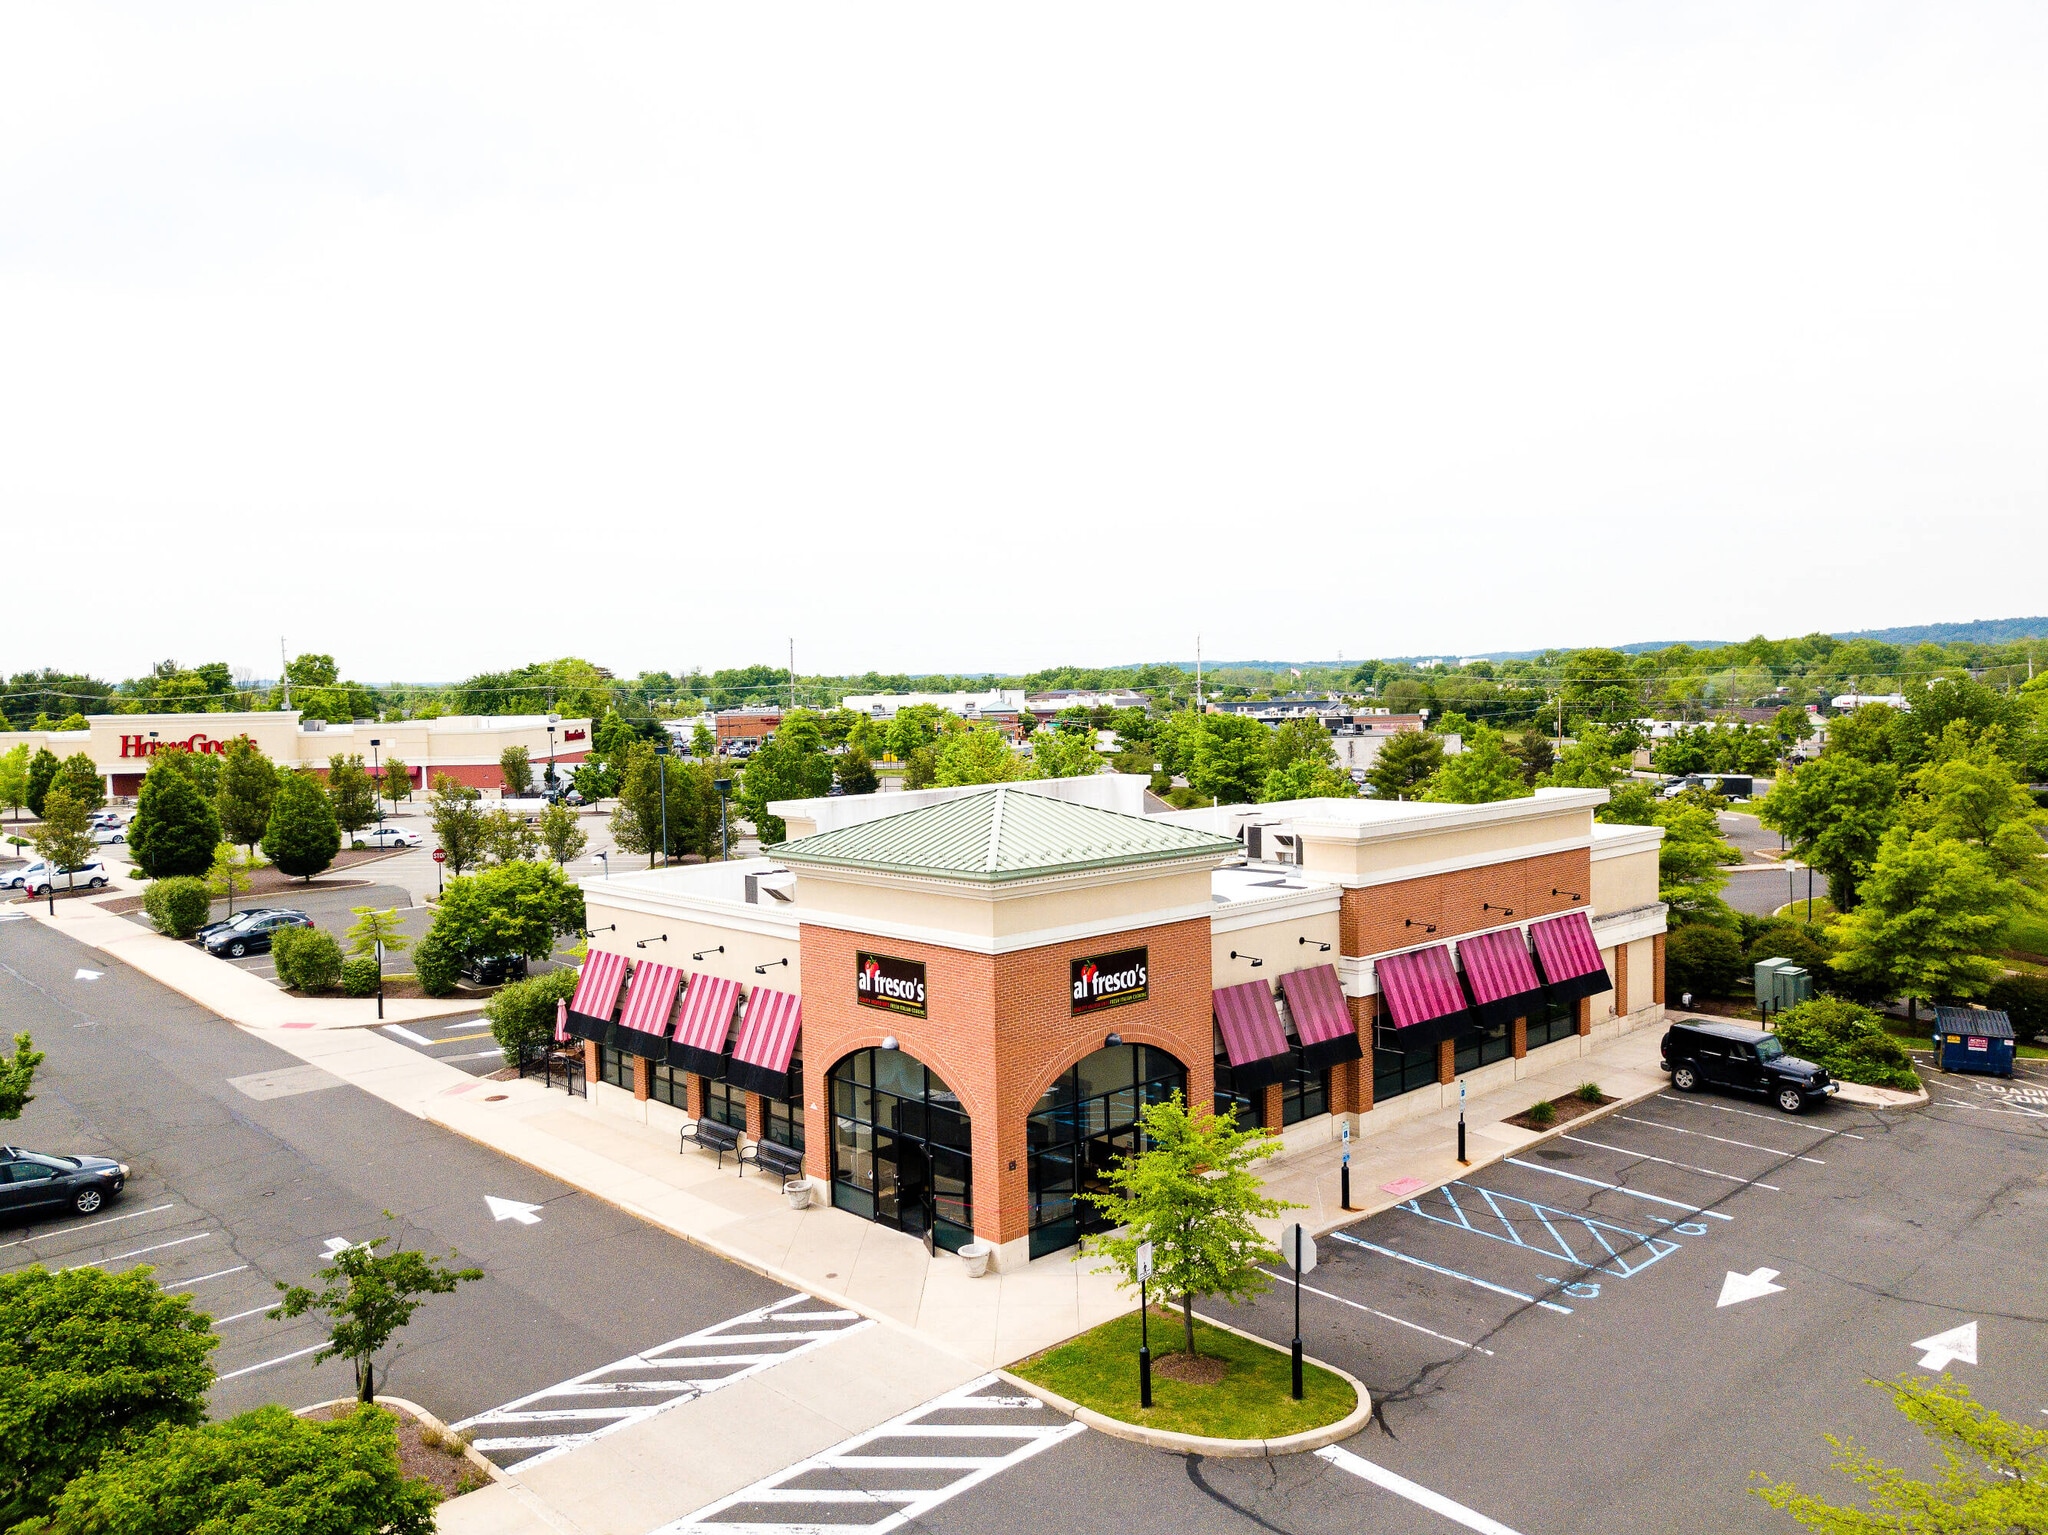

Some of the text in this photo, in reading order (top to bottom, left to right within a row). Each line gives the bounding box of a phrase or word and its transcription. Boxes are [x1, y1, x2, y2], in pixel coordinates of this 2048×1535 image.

[119, 733, 257, 758] HoGoos
[858, 969, 871, 991] al
[874, 970, 925, 1002] fresco's
[1073, 963, 1147, 999] al fresco's
